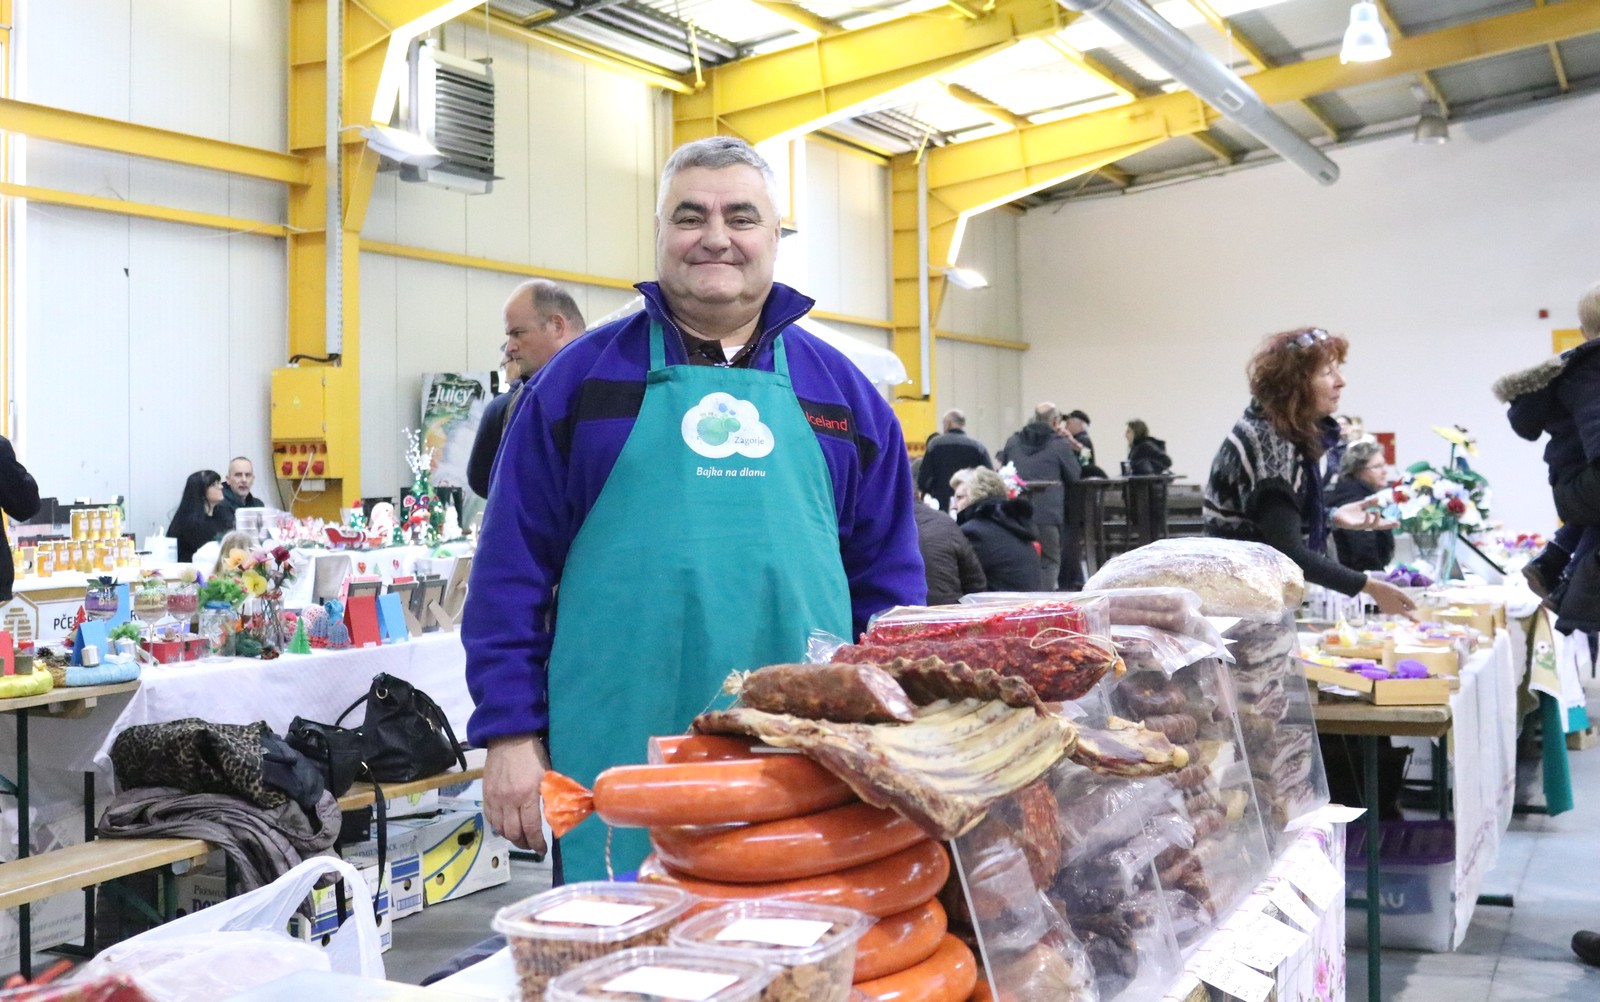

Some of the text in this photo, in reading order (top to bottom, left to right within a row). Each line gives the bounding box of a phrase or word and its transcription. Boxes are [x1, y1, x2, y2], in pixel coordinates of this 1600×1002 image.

[805, 411, 848, 432] Iceland
[734, 436, 765, 446] Zagorje
[697, 467, 766, 478] Bajka na dlanu
